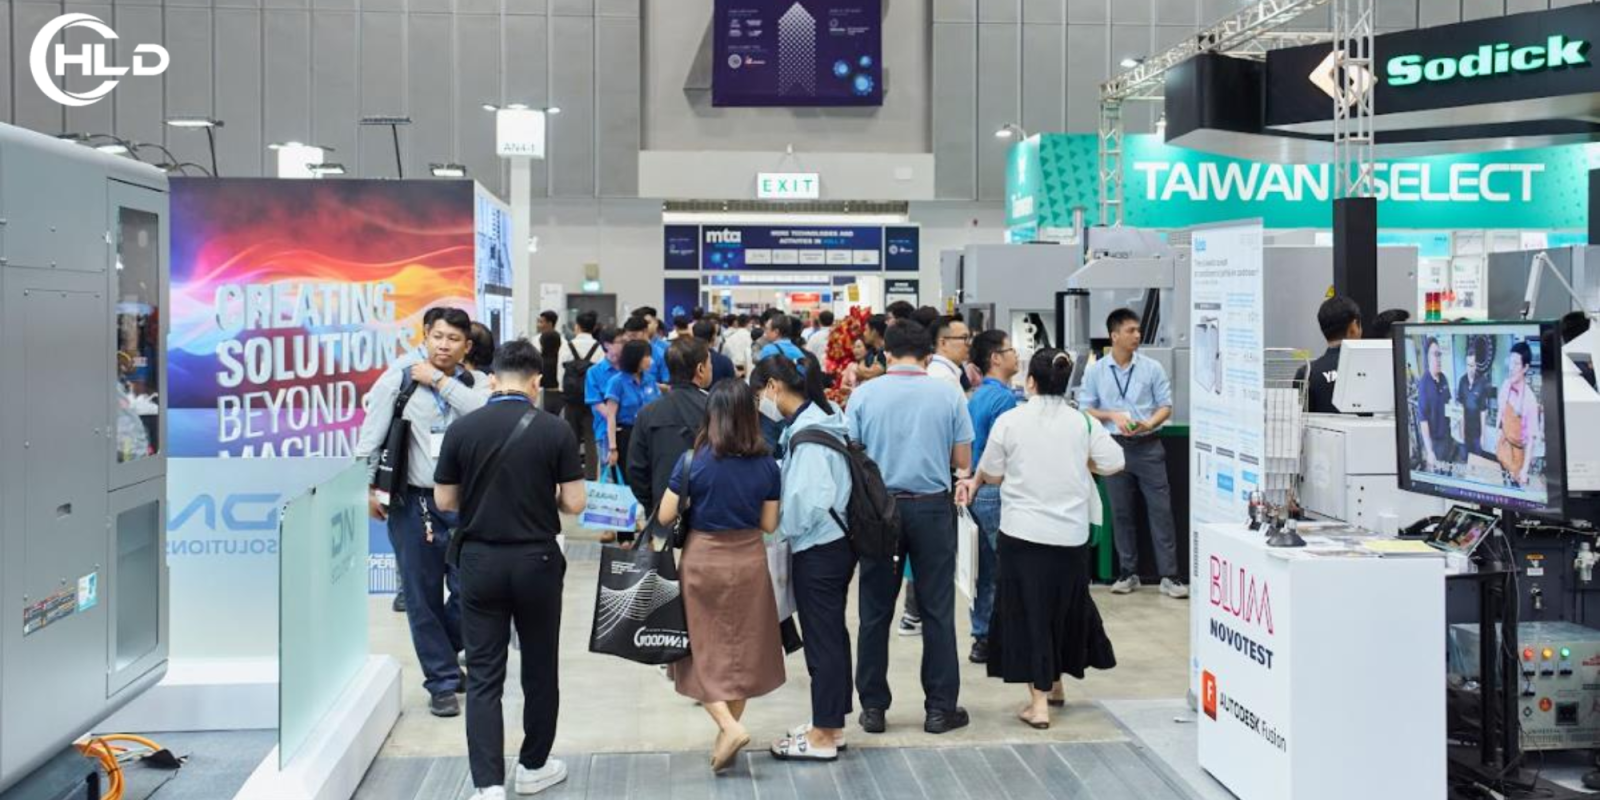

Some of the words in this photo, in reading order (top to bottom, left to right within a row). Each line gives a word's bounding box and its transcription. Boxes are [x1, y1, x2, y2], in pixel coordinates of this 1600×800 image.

[1387, 35, 1588, 86] Sodick
[762, 179, 814, 192] EXIT
[1134, 162, 1330, 202] TAIWAN
[1357, 161, 1546, 202] SELECT
[706, 228, 741, 243] mta
[215, 282, 396, 331] CREATING
[216, 325, 416, 388] SOLUTIONS
[217, 380, 357, 443] BEYOND
[1209, 554, 1274, 635] BLUM
[1209, 616, 1274, 670] NOVOTEST
[1219, 691, 1261, 736] AUTODESK
[1261, 719, 1287, 753] Fusion
